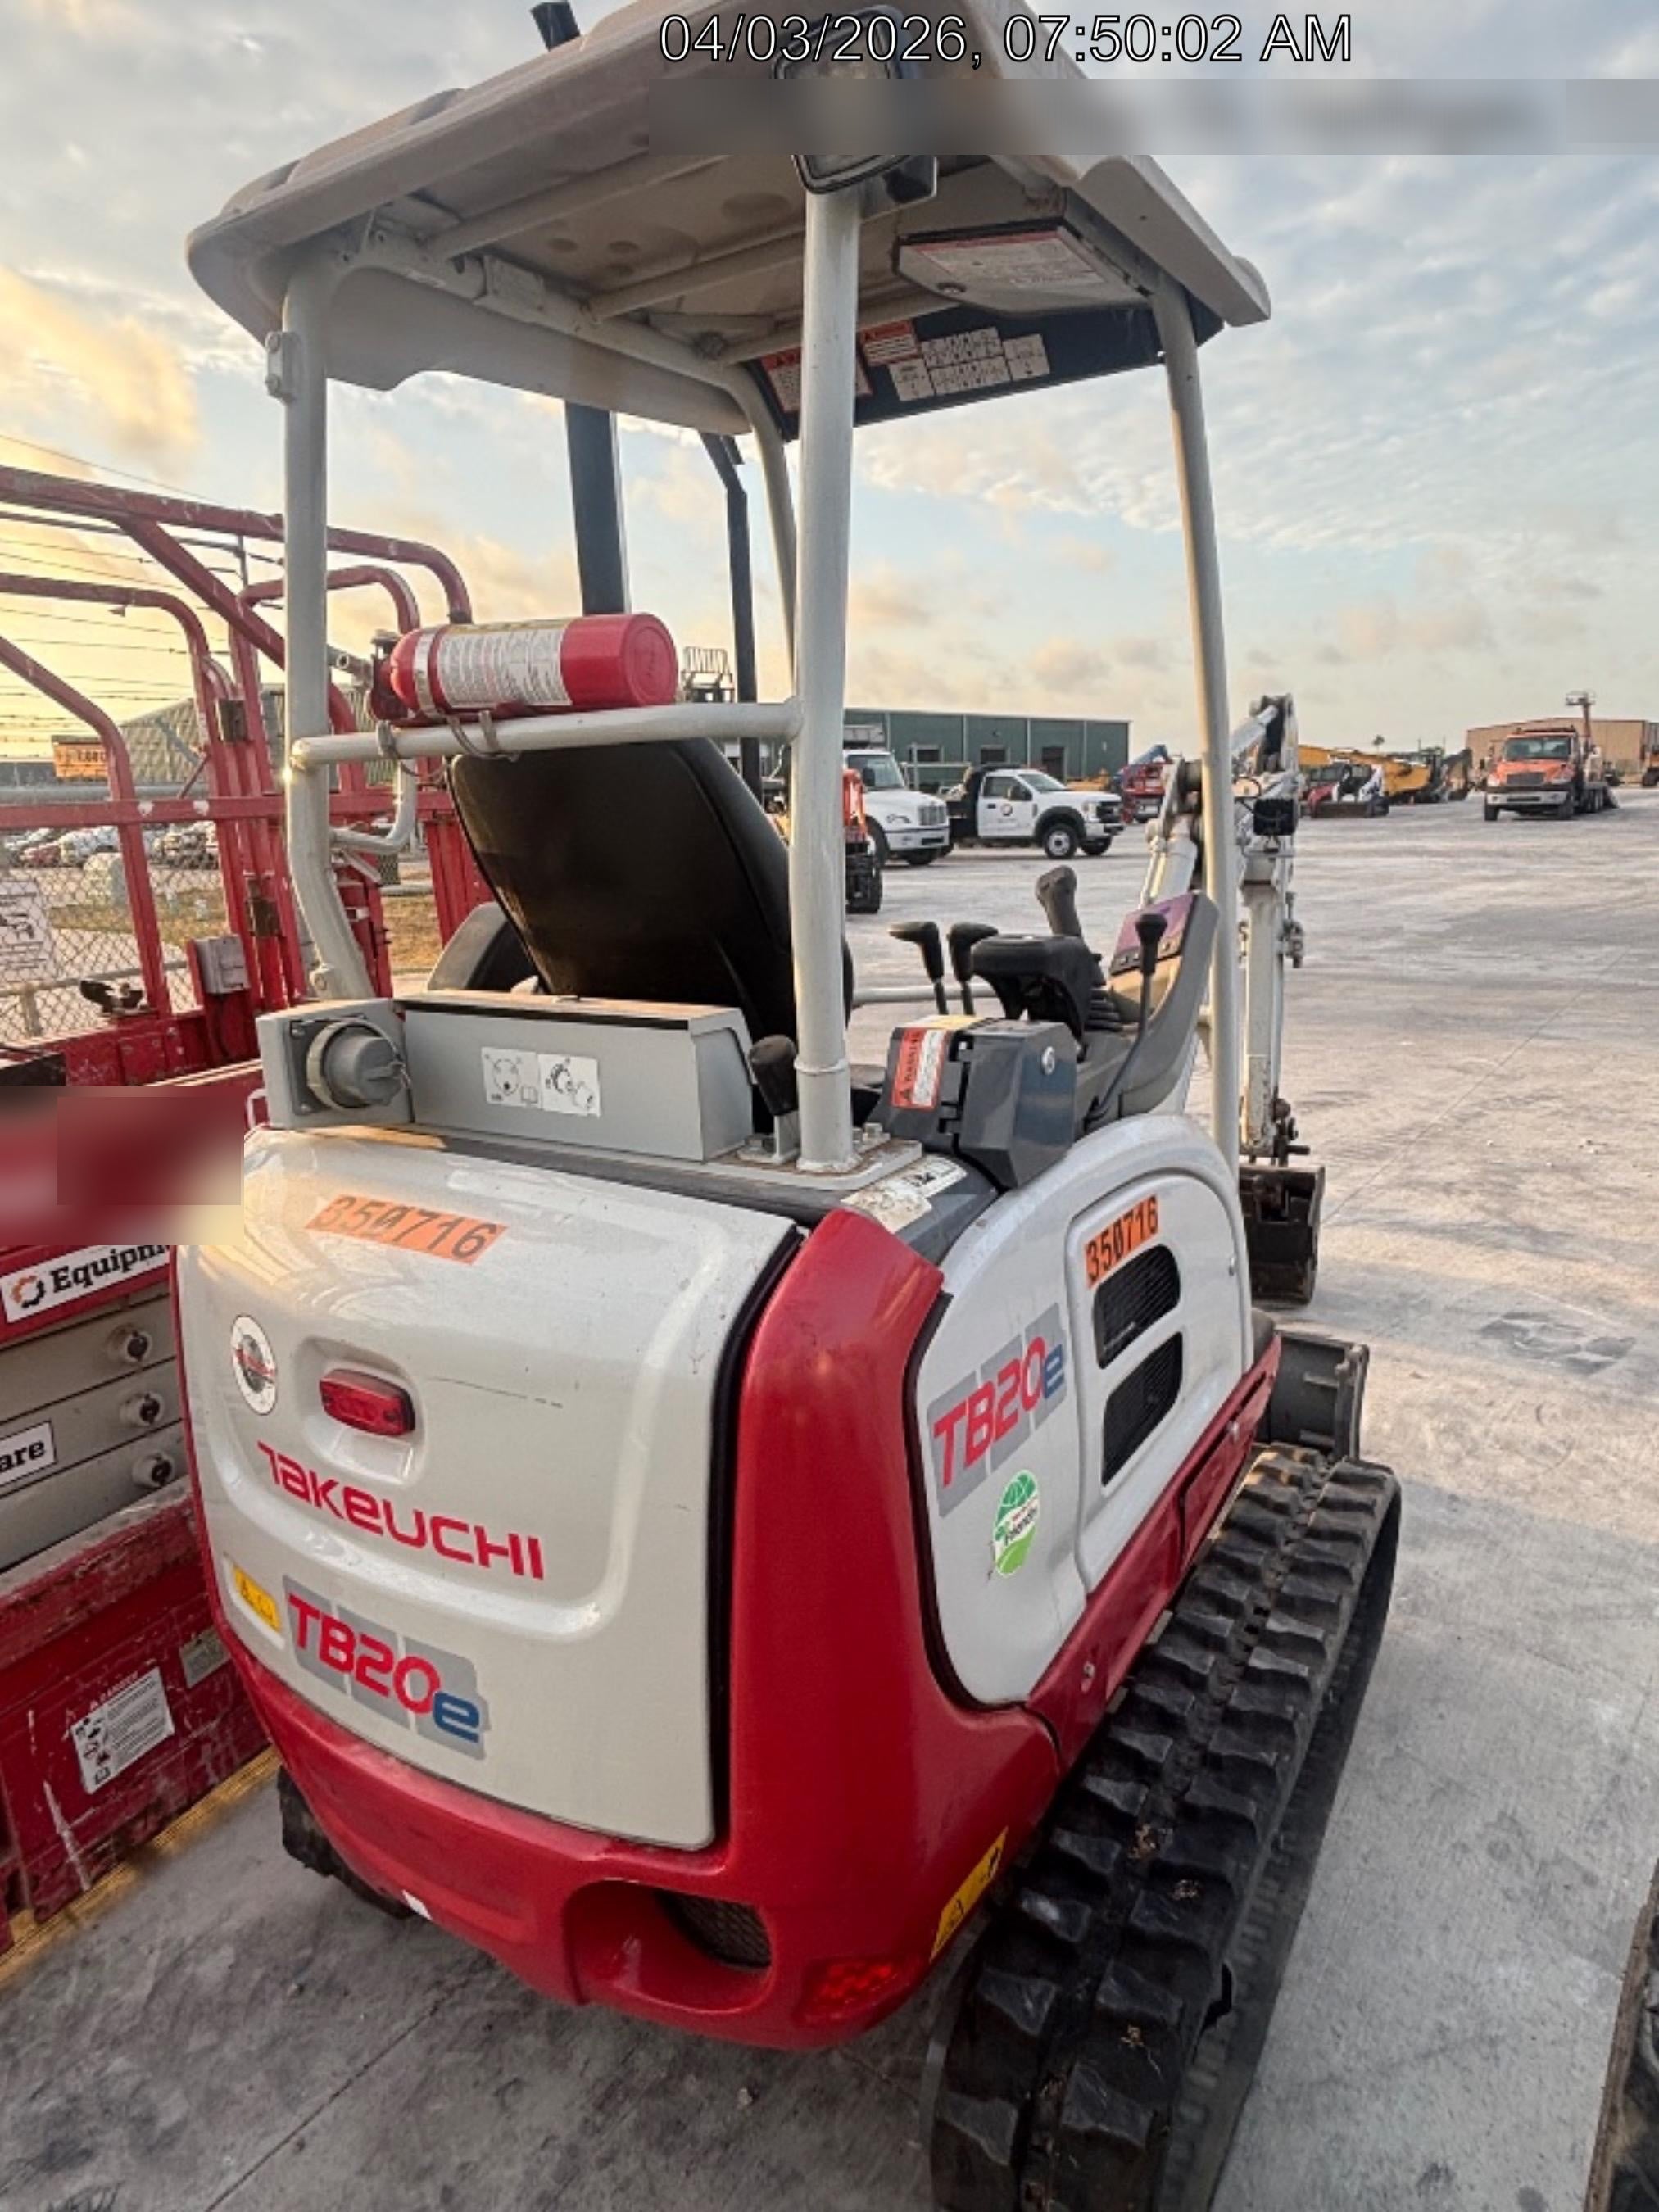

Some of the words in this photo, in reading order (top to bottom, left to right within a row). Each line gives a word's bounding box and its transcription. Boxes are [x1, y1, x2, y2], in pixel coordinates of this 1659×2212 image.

[50, 1245, 170, 1294] Equipm
[314, 1196, 497, 1259] 350716
[1087, 1195, 1158, 1282] 350716
[933, 1336, 1065, 1488] TB20e
[288, 1593, 480, 1743] TB20e
